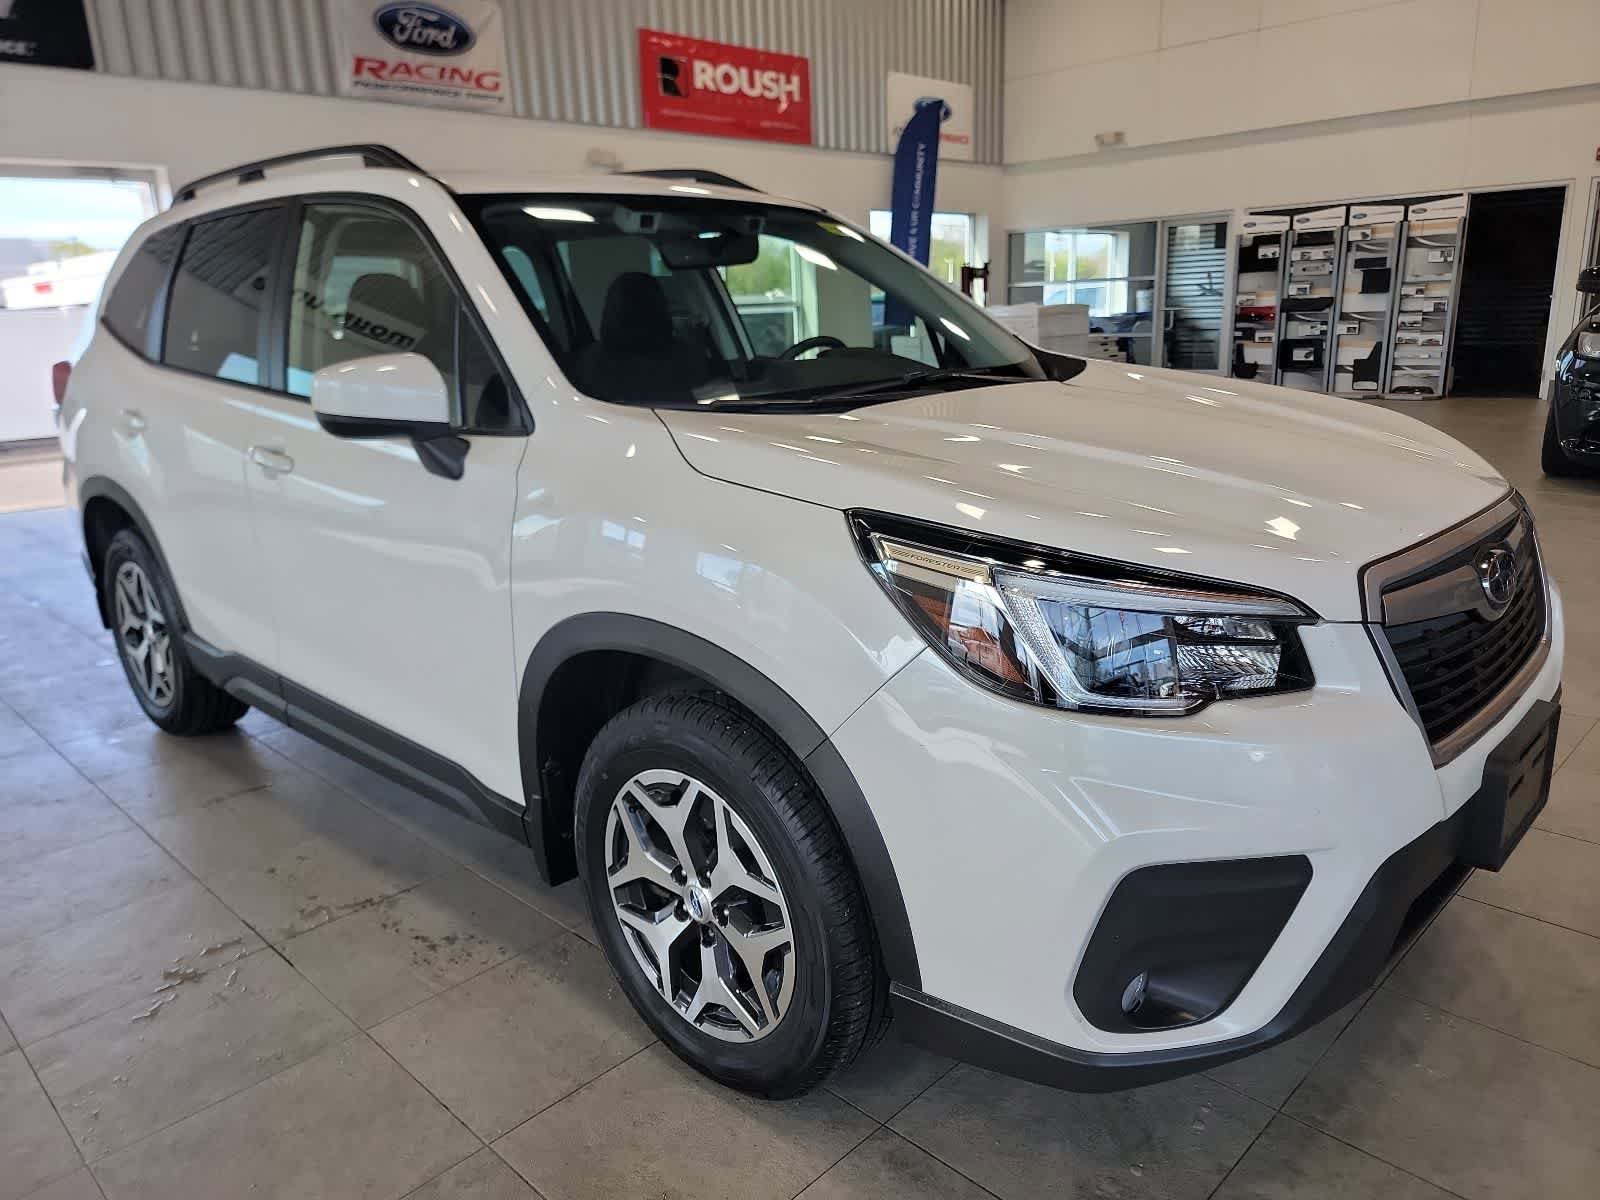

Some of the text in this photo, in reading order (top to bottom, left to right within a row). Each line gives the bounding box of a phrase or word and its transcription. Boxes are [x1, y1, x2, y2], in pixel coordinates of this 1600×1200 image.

[393, 10, 457, 49] Ford
[353, 56, 503, 92] RACING
[692, 58, 802, 103] ROUSH
[910, 554, 960, 570] FORESTER
